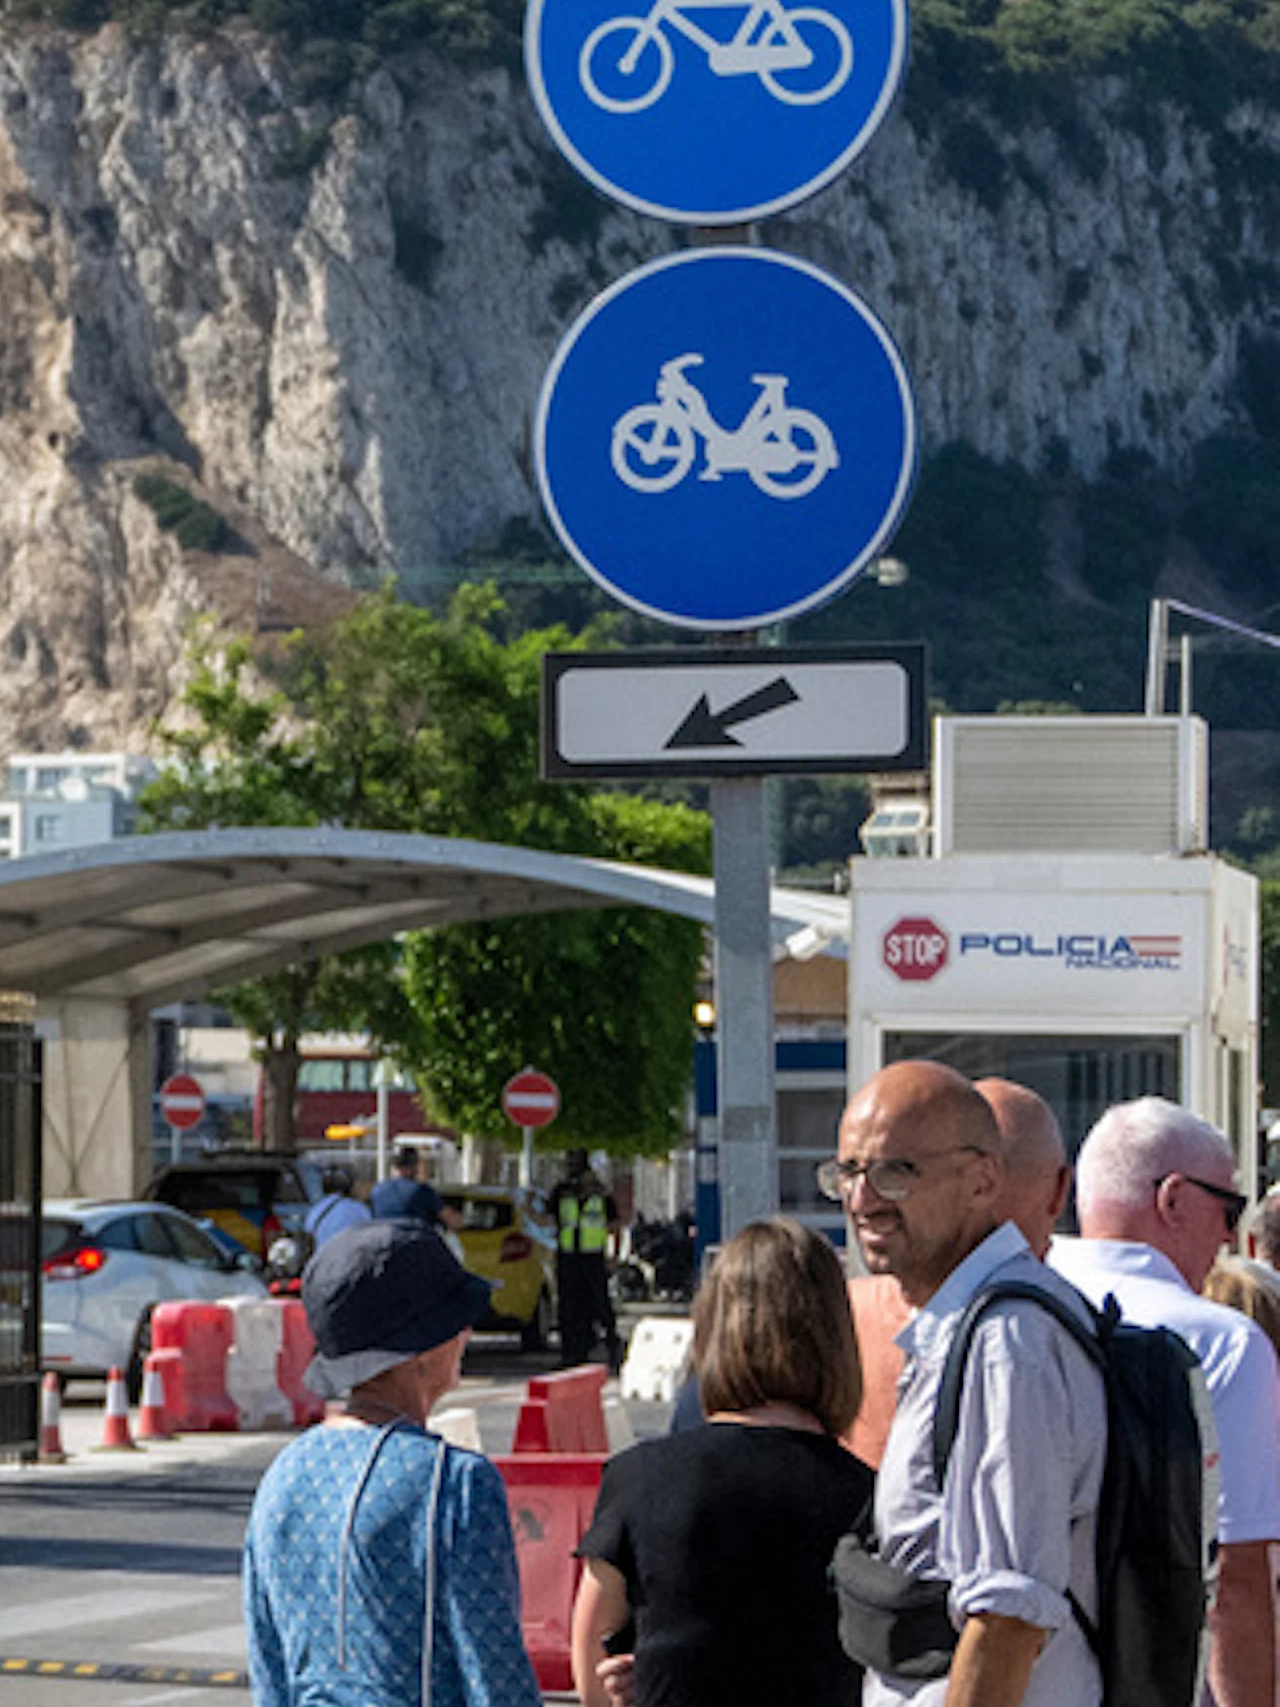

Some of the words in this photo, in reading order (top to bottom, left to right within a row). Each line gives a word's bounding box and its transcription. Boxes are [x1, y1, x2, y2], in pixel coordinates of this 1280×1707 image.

[886, 934, 945, 965] STOP
[960, 934, 1134, 956] POLICIA
[1066, 956, 1181, 970] NACIONAL
